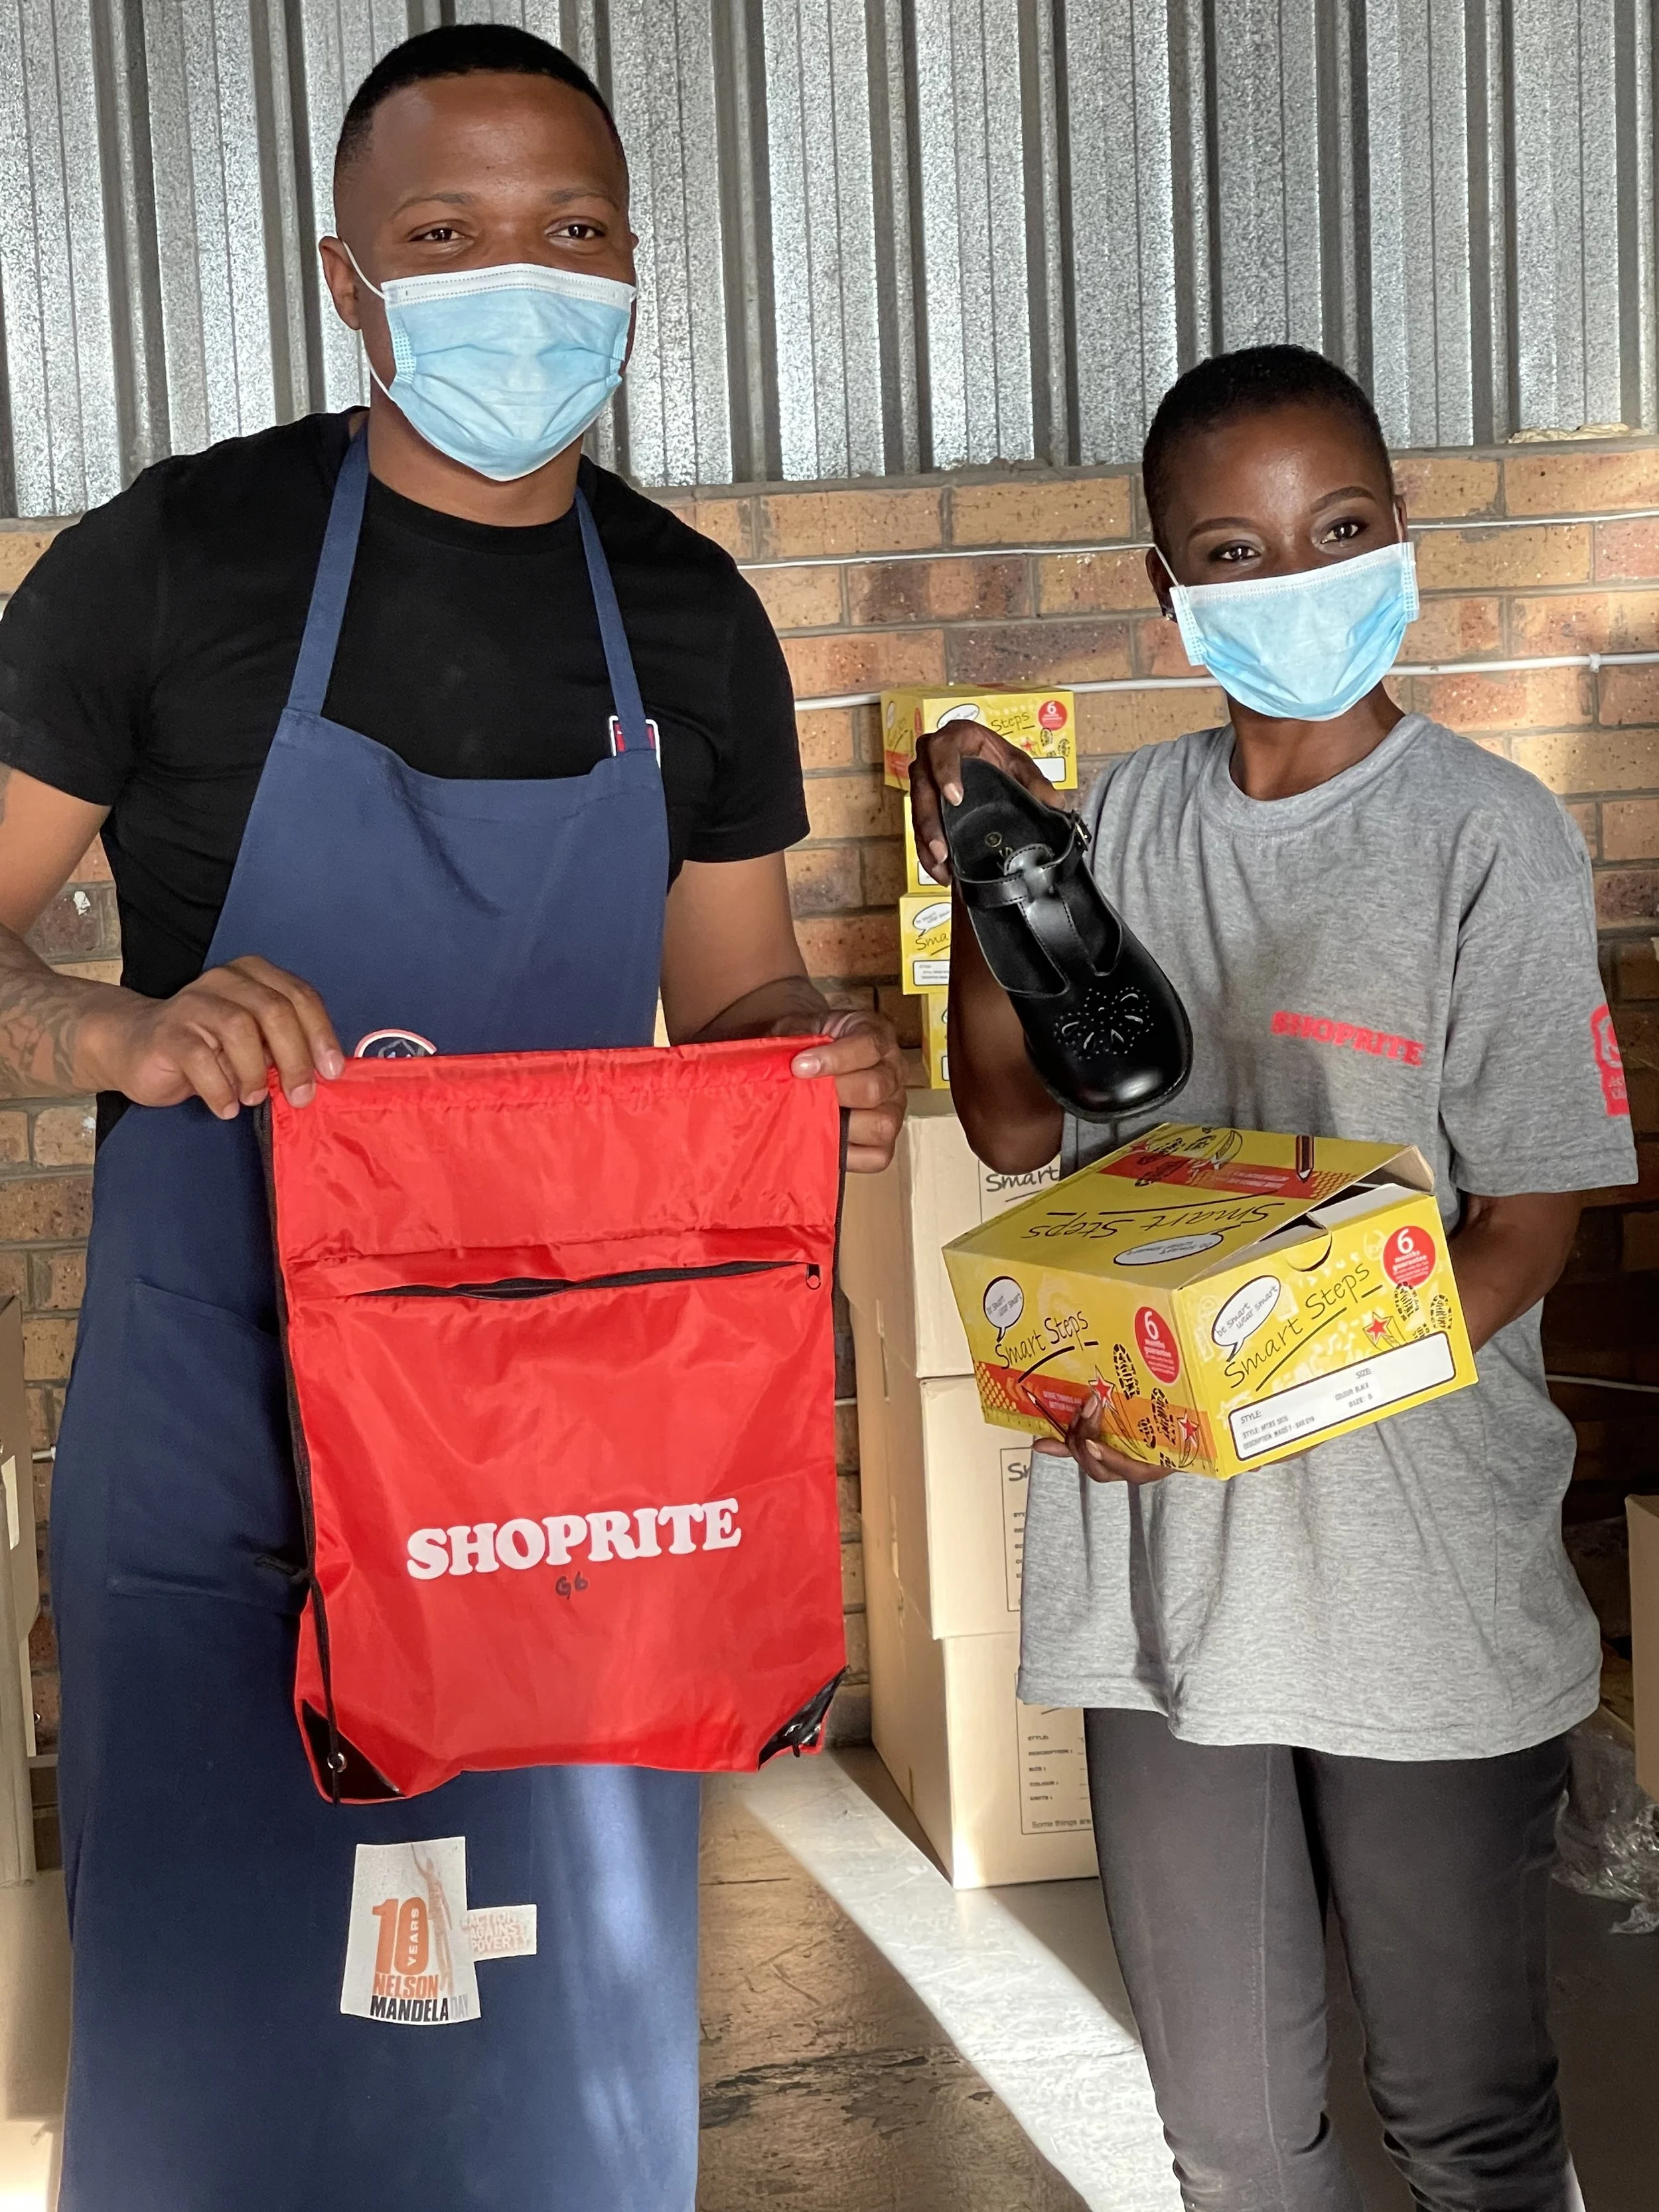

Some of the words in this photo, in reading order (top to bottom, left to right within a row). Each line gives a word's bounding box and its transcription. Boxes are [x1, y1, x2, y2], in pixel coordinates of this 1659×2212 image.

[991, 711, 1030, 731] Steps
[1046, 701, 1056, 714] 6
[1271, 1011, 1425, 1068] SHOPRITE
[986, 1166, 1059, 1192] Smart
[1021, 1211, 1135, 1239] Steps
[1141, 1203, 1285, 1232] Smart
[1397, 1228, 1414, 1254] 6
[1216, 1327, 1226, 1337] be
[1227, 1303, 1250, 1328] smart
[1236, 1309, 1253, 1329] wear
[1254, 1285, 1277, 1311] smart
[995, 1330, 1046, 1369] Smart
[1045, 1311, 1088, 1351] Steps
[1144, 1311, 1159, 1340] 6
[1224, 1319, 1303, 1388] Smart
[1305, 1263, 1370, 1320] Steps
[407, 1497, 742, 1580] SHOPRITE
[372, 1897, 429, 1975] 10
[407, 1907, 420, 1967] YEARS
[470, 1922, 525, 1939] AGAINST
[471, 1934, 532, 1953] POVERTY
[373, 1973, 439, 2001] NELSON
[370, 1995, 449, 2023] MANDELA
[450, 1993, 470, 2020] DAY
